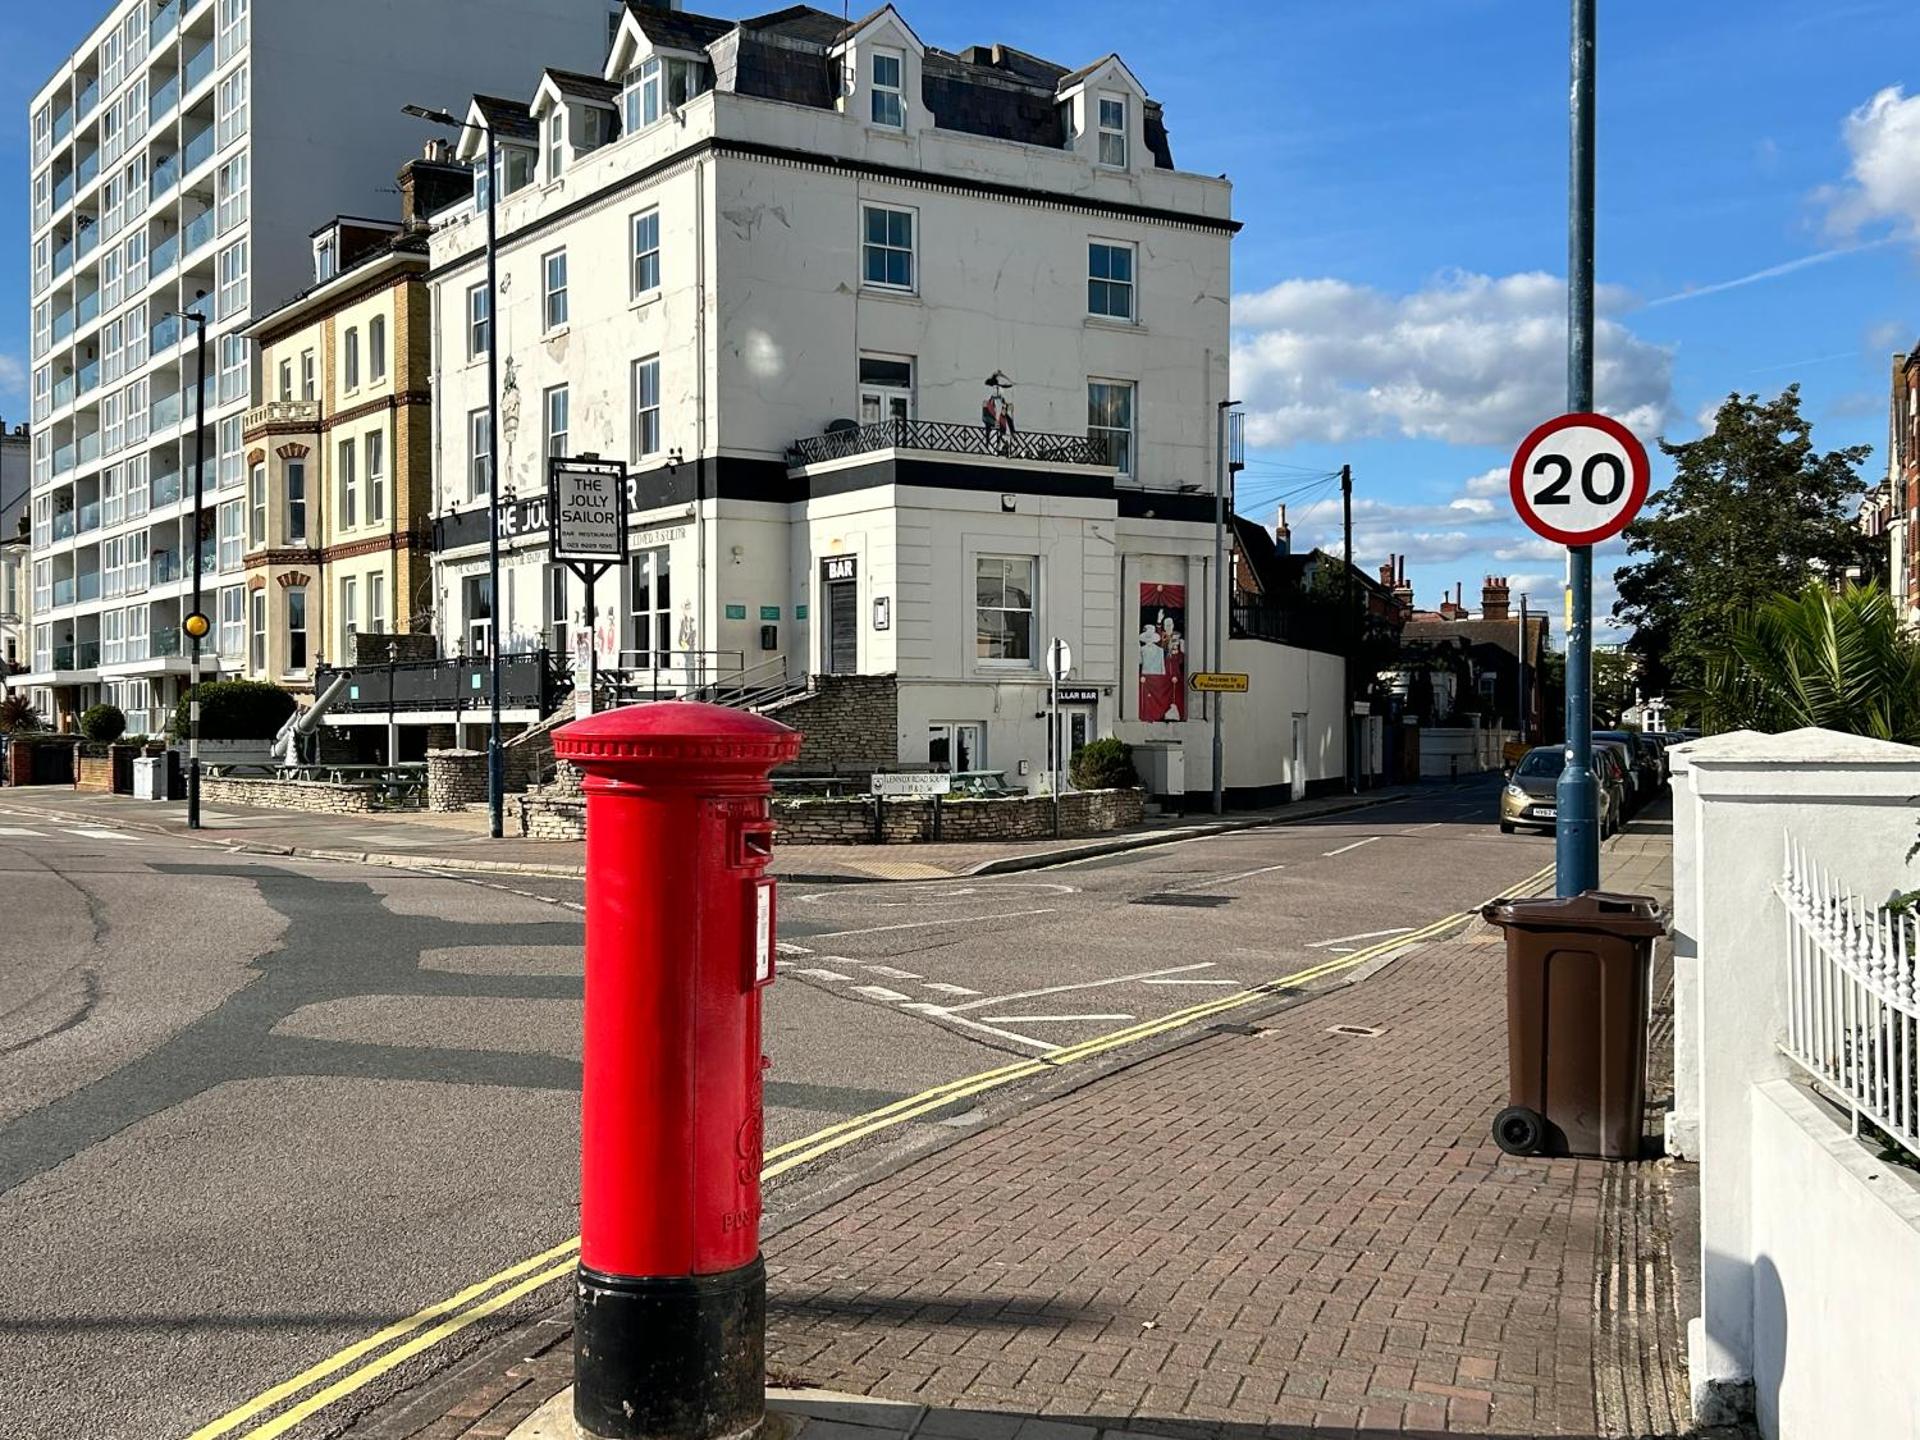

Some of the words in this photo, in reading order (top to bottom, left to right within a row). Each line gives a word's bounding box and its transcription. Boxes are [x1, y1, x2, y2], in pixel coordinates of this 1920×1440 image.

[573, 478, 602, 491] THE
[1532, 452, 1626, 506] 20
[568, 494, 609, 507] JOLLY
[487, 505, 517, 537] HE
[562, 510, 615, 524] SAILOR
[828, 560, 853, 579] BAR
[912, 775, 928, 783] ROAD
[929, 775, 949, 783] SOUTH
